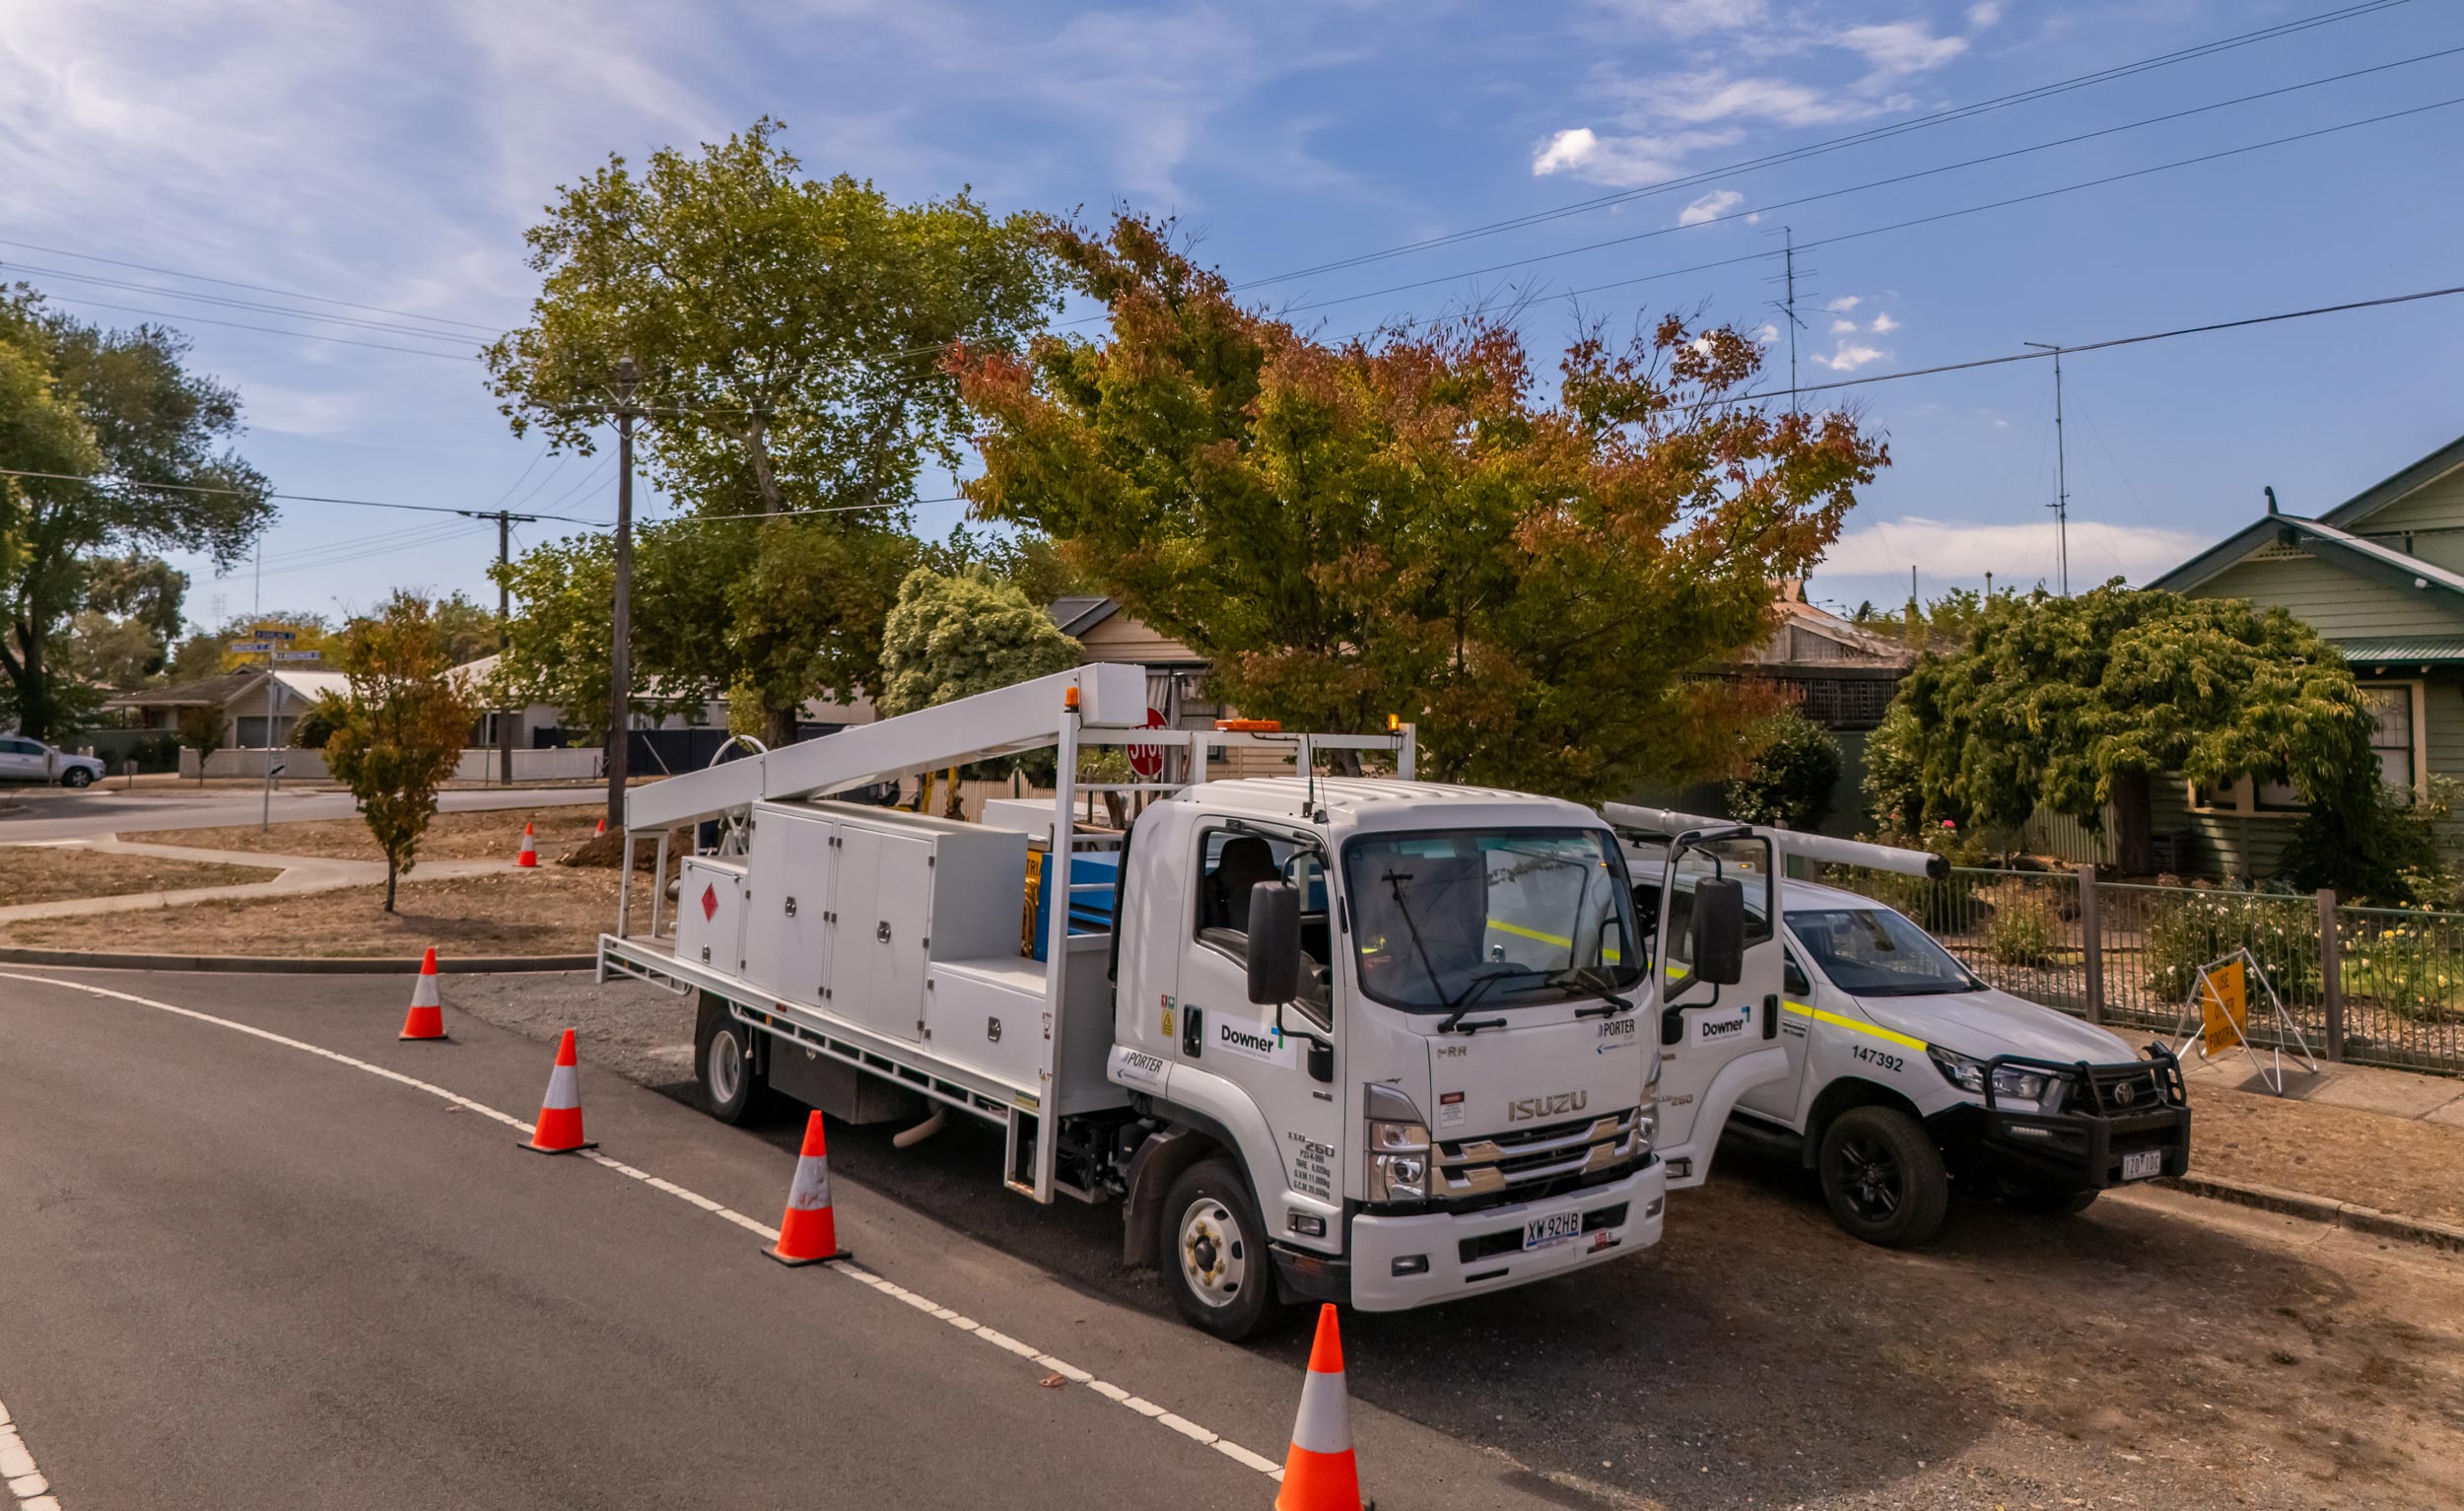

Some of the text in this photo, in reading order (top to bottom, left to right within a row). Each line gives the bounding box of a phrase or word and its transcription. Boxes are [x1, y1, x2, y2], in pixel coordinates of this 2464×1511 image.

[2217, 972, 2229, 991] USE
[1603, 1018, 1635, 1037] PORTER
[1702, 1019, 1744, 1037] Downer
[1221, 1024, 1273, 1054] Downer
[1128, 1052, 1163, 1073] PORTER
[1437, 1046, 1467, 1059] FRR
[1853, 1045, 1903, 1072] 147392
[1508, 1089, 1587, 1122] ISUZU
[1287, 1131, 1335, 1158] 110 260
